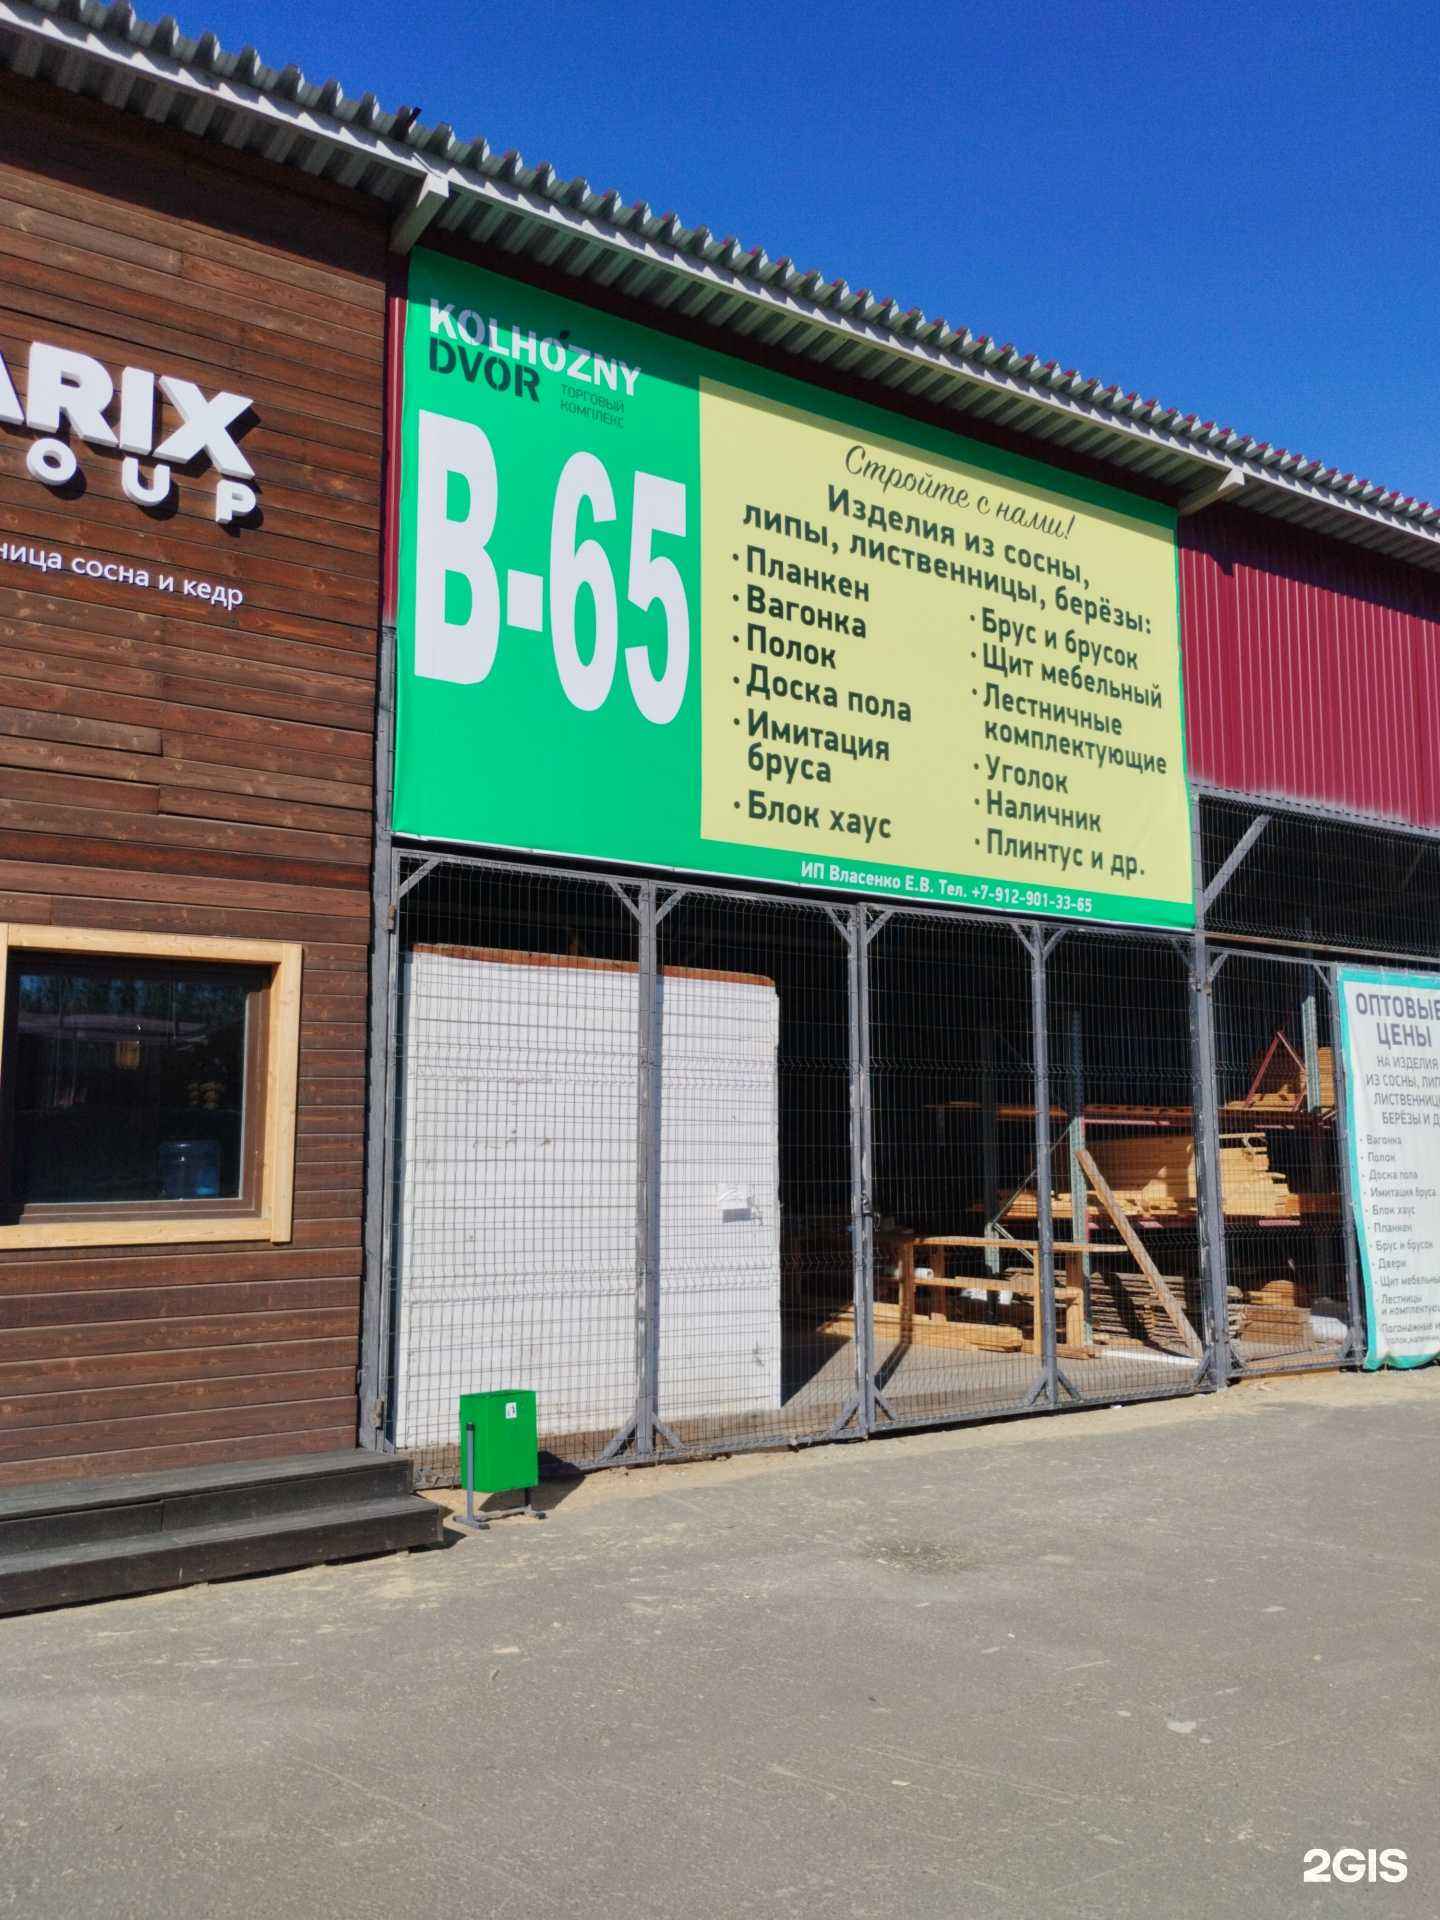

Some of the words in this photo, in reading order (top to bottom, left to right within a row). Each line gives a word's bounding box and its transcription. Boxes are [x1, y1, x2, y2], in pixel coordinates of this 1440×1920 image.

[429, 337, 540, 403] DVOR
[0, 341, 255, 478] RIX
[560, 383, 625, 413] ТОРГОВЫЙ
[560, 400, 625, 429] КОМПЛЕКС
[845, 445, 970, 508] Стройте
[976, 496, 991, 514] с
[996, 501, 1076, 540] нами!
[828, 484, 955, 547] Изделия
[965, 532, 994, 557] из
[1004, 544, 1090, 589] сосны,
[71, 557, 149, 588] сосна
[158, 574, 174, 591] и
[183, 578, 243, 610] кедр
[743, 504, 838, 555] липы,
[850, 534, 1046, 610] лиственницы,
[1055, 585, 1151, 634] берёзы:
[747, 545, 869, 602] Планкен
[747, 584, 866, 639] Вагонка
[747, 622, 836, 669] Полок
[982, 607, 1037, 646] Брус
[1044, 629, 1057, 649] и
[1065, 629, 1138, 670] брусок
[746, 663, 838, 708] Доска
[848, 691, 912, 722] пола
[983, 643, 1034, 677] Щит
[1041, 665, 1162, 708] мебельный
[983, 682, 1122, 735] Лестничные
[747, 708, 890, 762] Имитация
[984, 721, 1167, 774] комплектующие
[748, 742, 831, 784] бруса
[985, 754, 1068, 793] Уголок
[748, 789, 819, 828] Блок
[830, 809, 892, 843] хаус
[986, 789, 1101, 832] Наличник
[987, 828, 1083, 871] Плинтус
[1091, 850, 1103, 869] и
[1111, 854, 1145, 880] др.
[801, 861, 824, 878] ИП
[829, 864, 900, 889] Власенко
[939, 879, 967, 898] Тел.
[972, 884, 1093, 912] +7-912-901-33-65
[1377, 1022, 1432, 1050] ЦЕНЫ
[1366, 1074, 1380, 1086] ИЗ
[1383, 1074, 1420, 1090] СОСНЫ,
[1376, 1056, 1390, 1067] НА
[1393, 1056, 1439, 1071] ИЗДЕЛИЯ
[1366, 1134, 1402, 1145] Вагонка
[1424, 1113, 1430, 1125] И
[1368, 1152, 1396, 1163] Полок
[1369, 1169, 1398, 1182] Доска
[1370, 1187, 1413, 1198] Имитация
[1372, 1204, 1395, 1216] Блок
